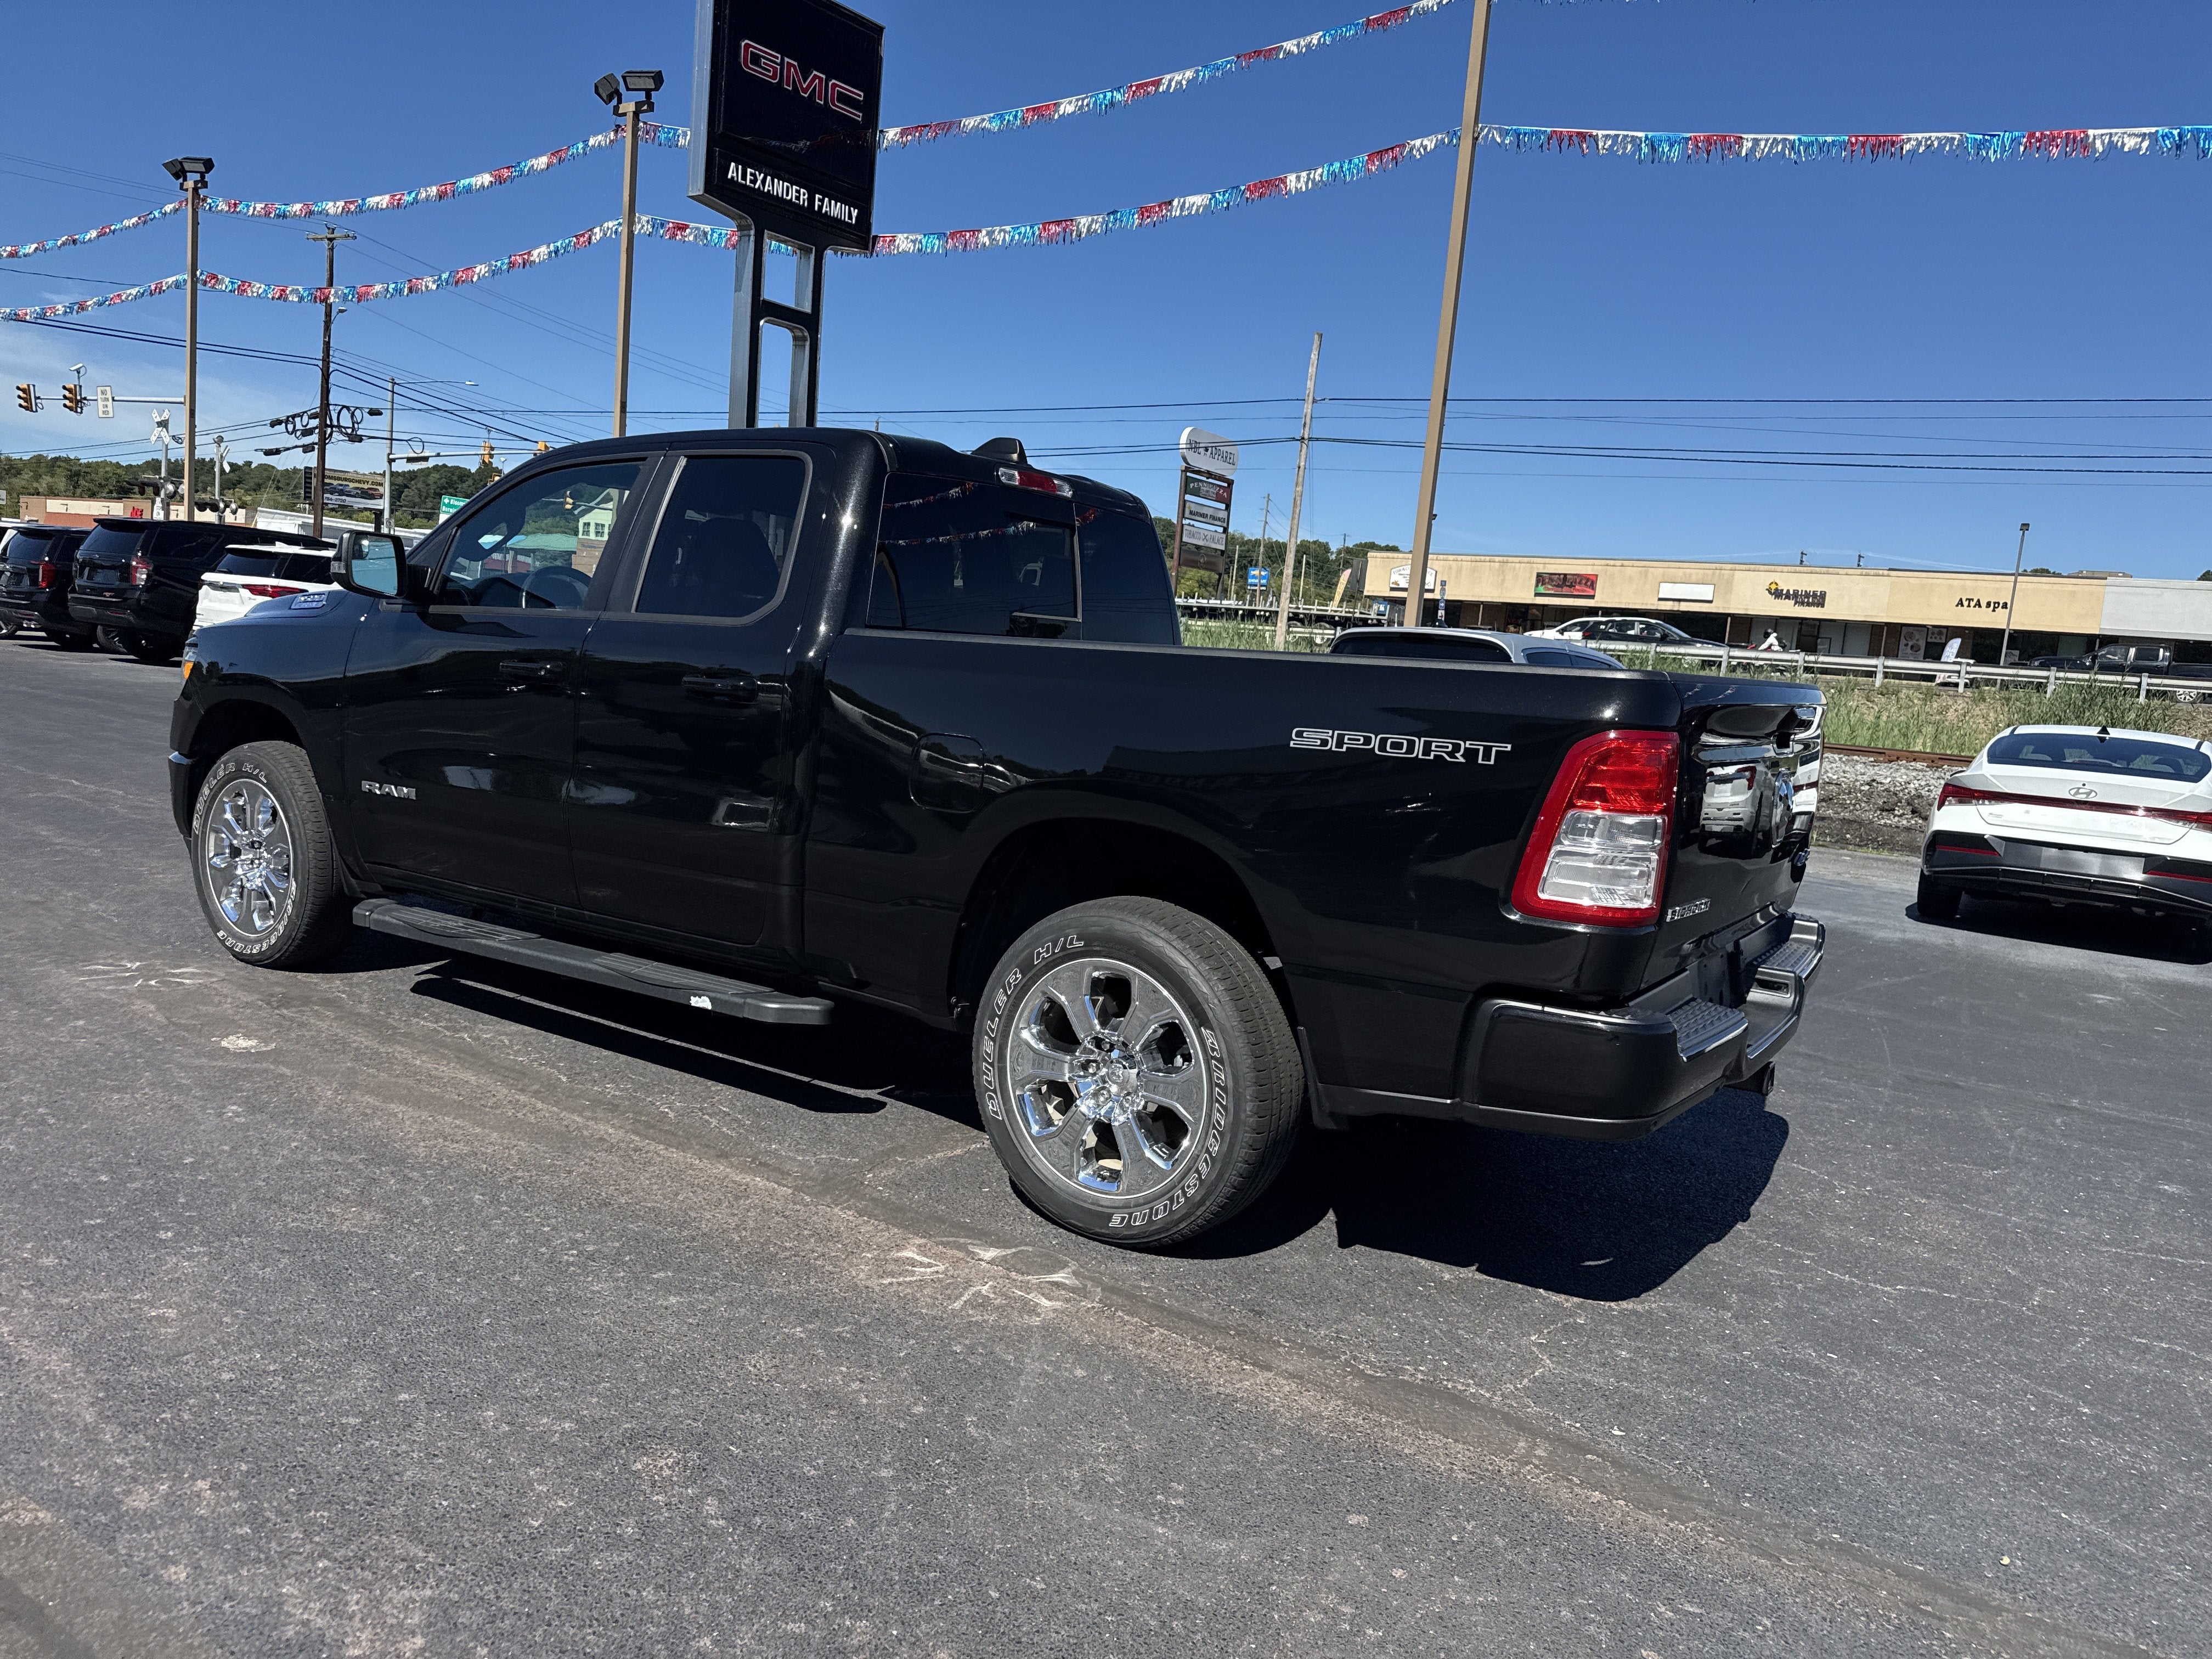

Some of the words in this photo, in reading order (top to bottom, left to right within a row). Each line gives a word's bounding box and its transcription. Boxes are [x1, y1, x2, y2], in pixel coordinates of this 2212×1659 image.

[741, 39, 864, 121] GMC
[727, 162, 808, 207] ALEXANDER
[815, 194, 858, 224] FAMILY
[1209, 447, 1235, 465] APPAREL
[325, 475, 383, 487] OMSBURGCHEVY.COM
[1209, 484, 1227, 499] PIZZA
[1189, 510, 1209, 520] MARINER
[1209, 514, 1226, 524] FINANCE
[1185, 528, 1201, 540] TOBACCO
[1209, 534, 1224, 546] PALACE
[1774, 588, 1827, 598] MARINER
[1955, 597, 1982, 608] ATA
[1985, 600, 2008, 612] spa
[1290, 727, 1512, 765] SPORT
[362, 780, 416, 800] RAM
[983, 968, 1022, 1120] DUELER
[1034, 935, 1084, 964] H/L
[1109, 1026, 1227, 1227] BRIDGESTONE
